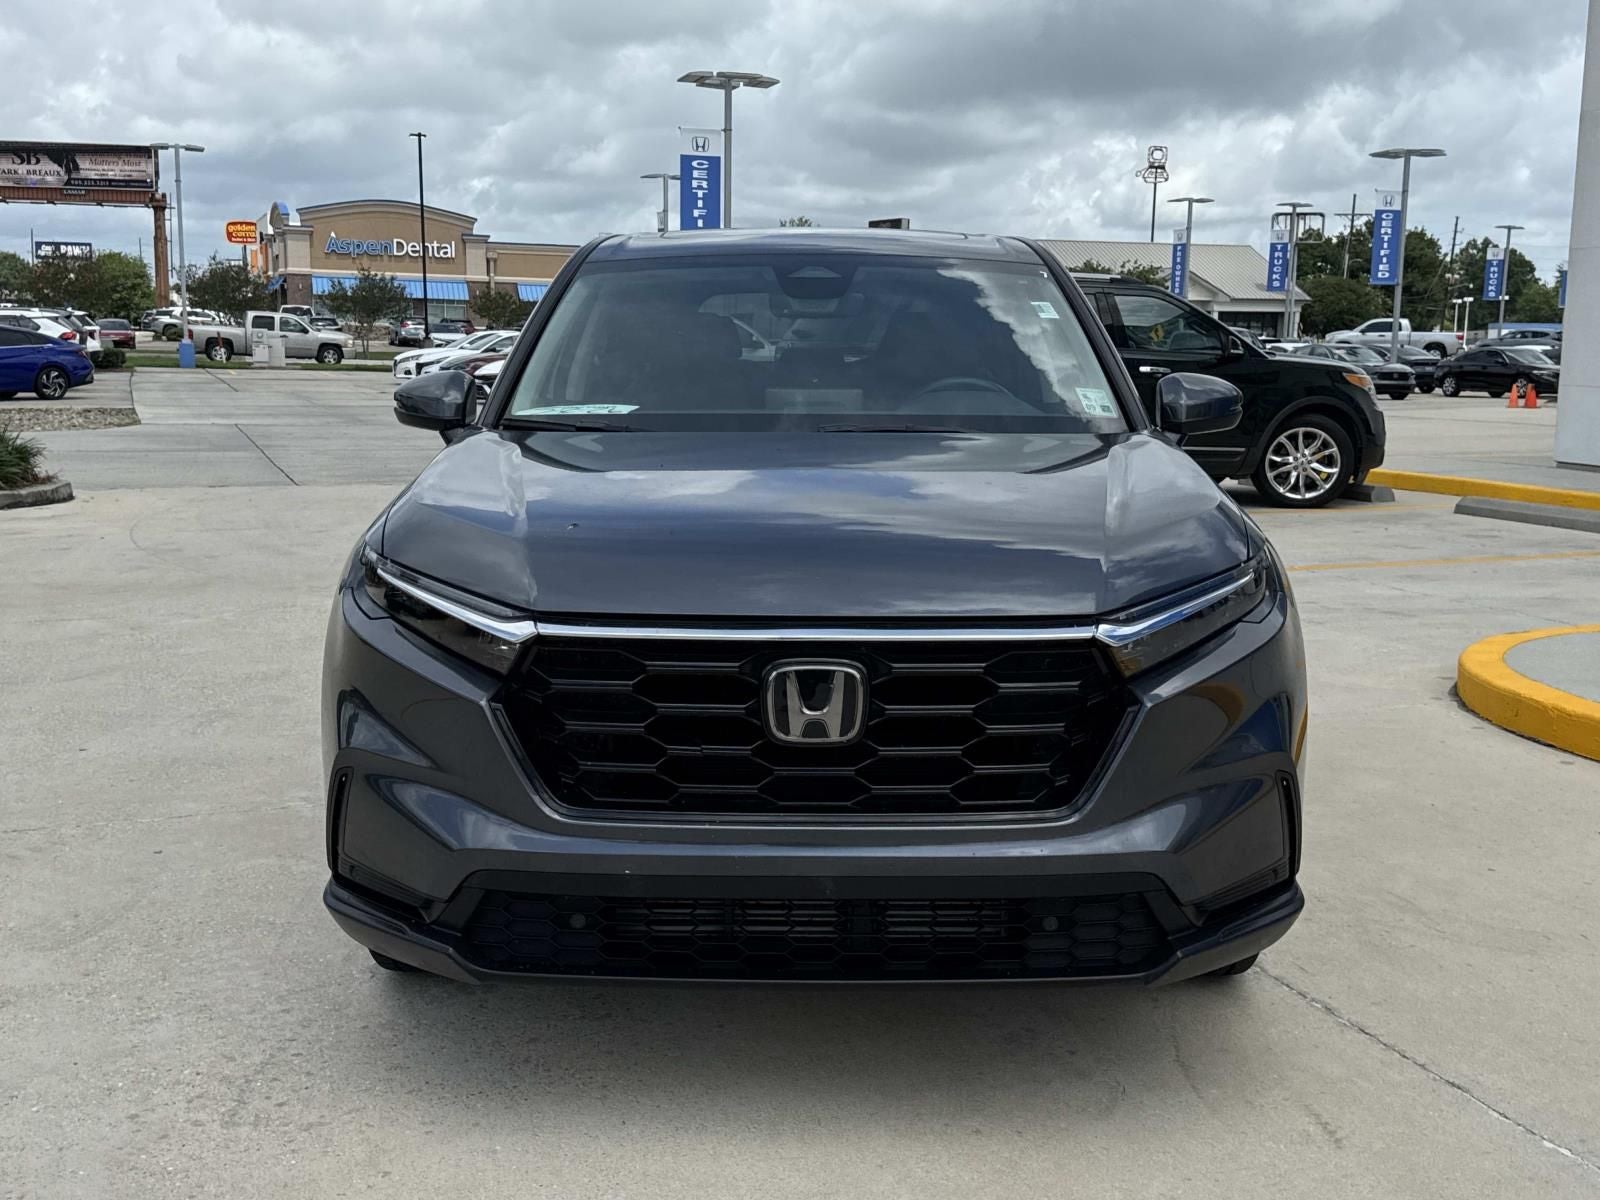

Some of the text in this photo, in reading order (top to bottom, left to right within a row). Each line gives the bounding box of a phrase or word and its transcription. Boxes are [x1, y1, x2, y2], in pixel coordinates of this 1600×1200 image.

[0, 168, 62, 177] ARK BREAUX
[88, 158, 142, 167] Matters Most
[691, 159, 710, 228] CERTIFI
[227, 223, 256, 233] golden
[324, 231, 456, 258] AspenDental
[1377, 212, 1394, 279] CERTIFIED
[1272, 244, 1284, 288] TRUCKS
[1488, 260, 1499, 297] TRUCKS
